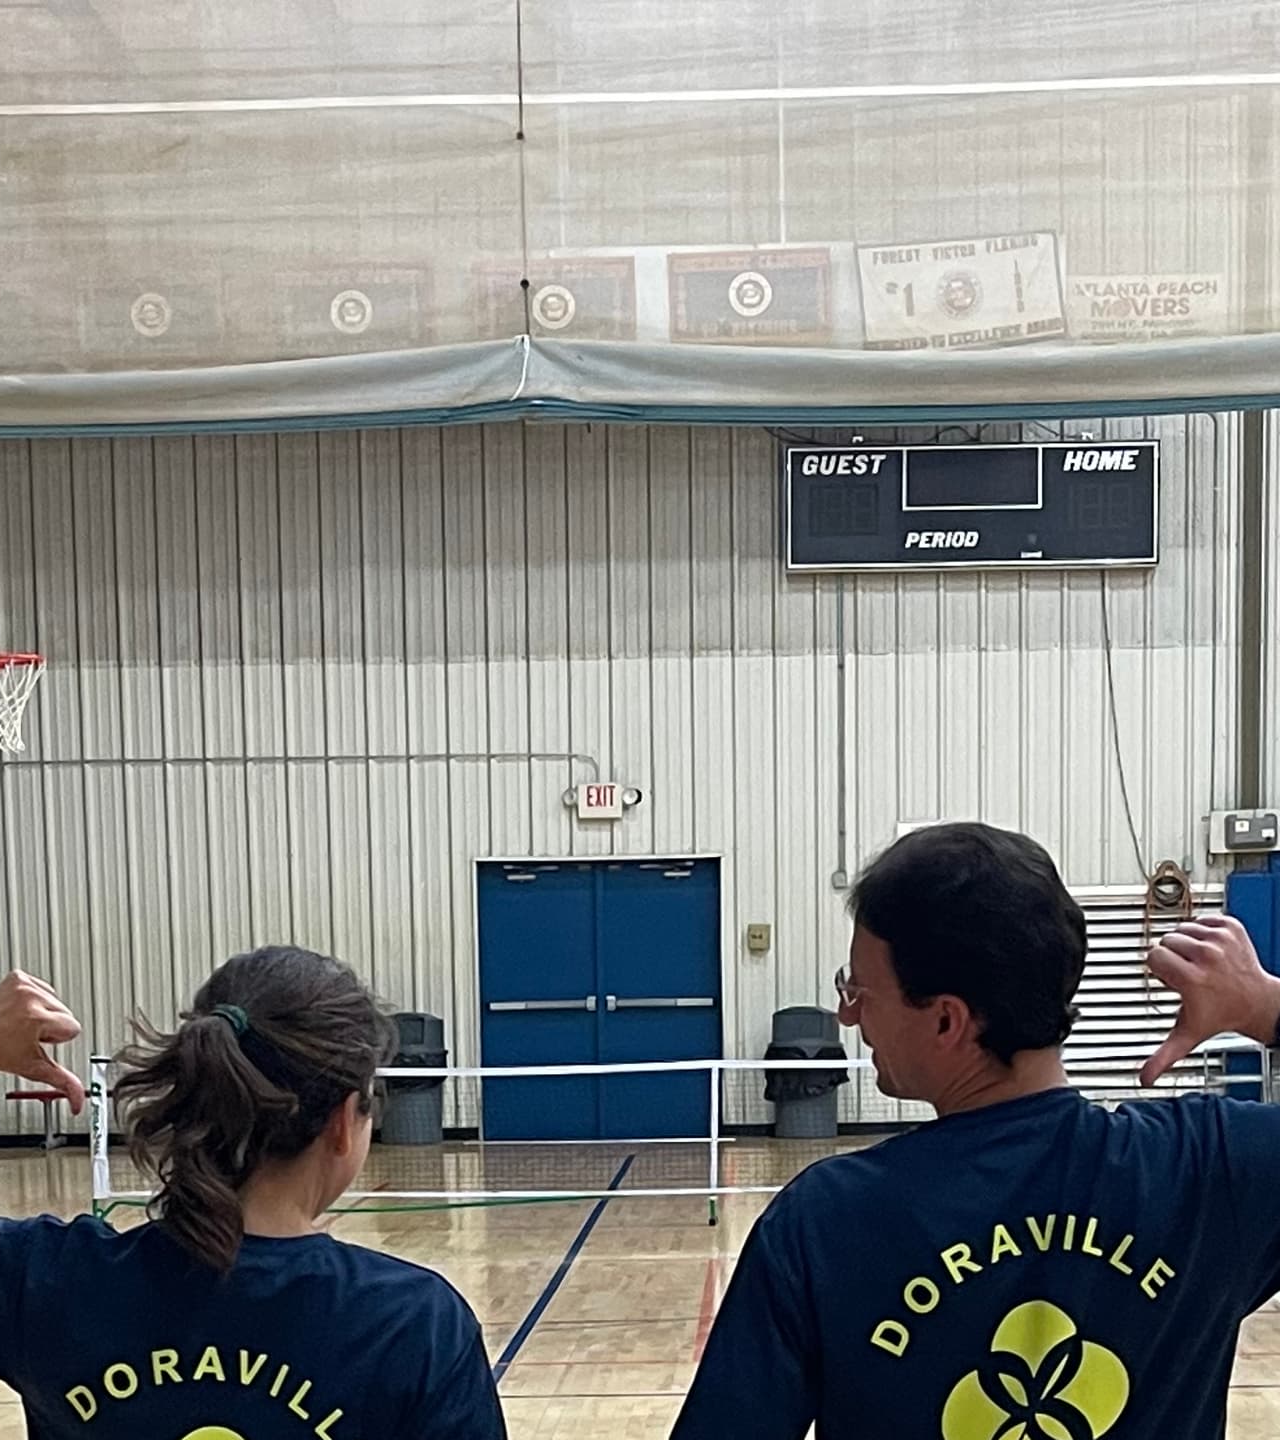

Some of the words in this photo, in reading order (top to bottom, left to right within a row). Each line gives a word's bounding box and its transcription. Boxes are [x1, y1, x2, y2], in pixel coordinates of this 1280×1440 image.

[1073, 281, 1150, 298] ATLANTA
[1157, 279, 1218, 296] PEACH
[1091, 297, 1190, 318] MOVERS
[802, 454, 885, 475] GUEST
[1063, 449, 1139, 472] HOME
[904, 530, 980, 549] PERIOD
[586, 785, 616, 807] EXIT
[870, 1213, 1176, 1357] DORAVILLE
